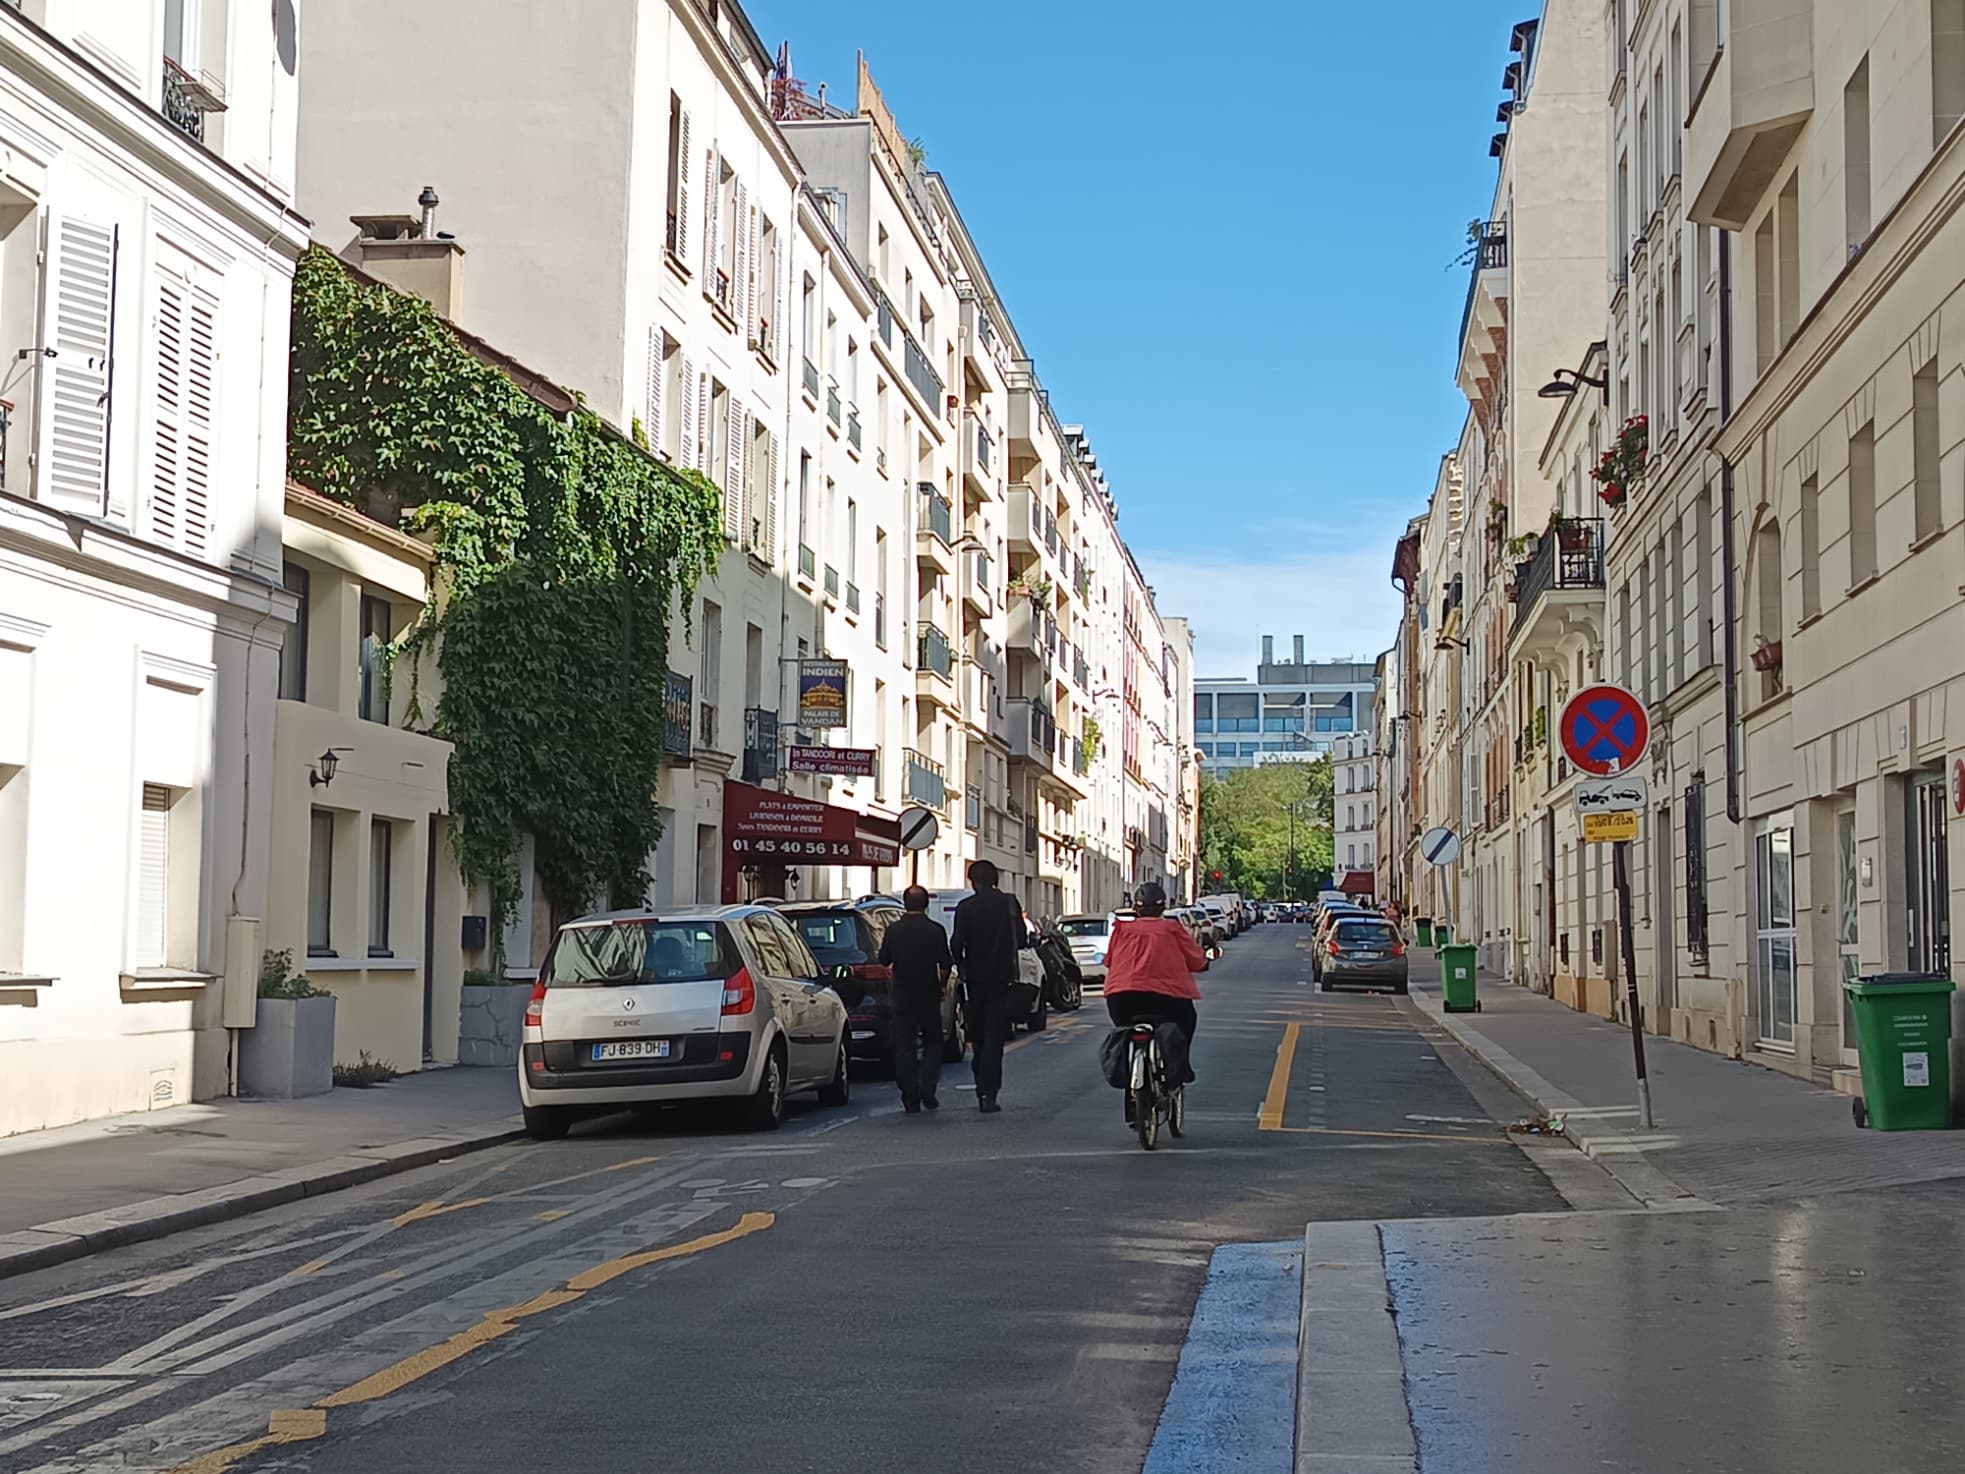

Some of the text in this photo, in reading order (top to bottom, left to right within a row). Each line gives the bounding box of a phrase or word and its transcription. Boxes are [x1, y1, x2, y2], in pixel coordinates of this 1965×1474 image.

[802, 668, 844, 677] INDIEN
[846, 751, 871, 761] CURRY
[792, 760, 870, 774] Salle climatisée
[759, 801, 781, 809] PLATS
[732, 839, 750, 851] 01
[755, 840, 776, 852] 45
[780, 841, 801, 853] 40
[805, 842, 826, 854] 56
[832, 843, 850, 855] 14
